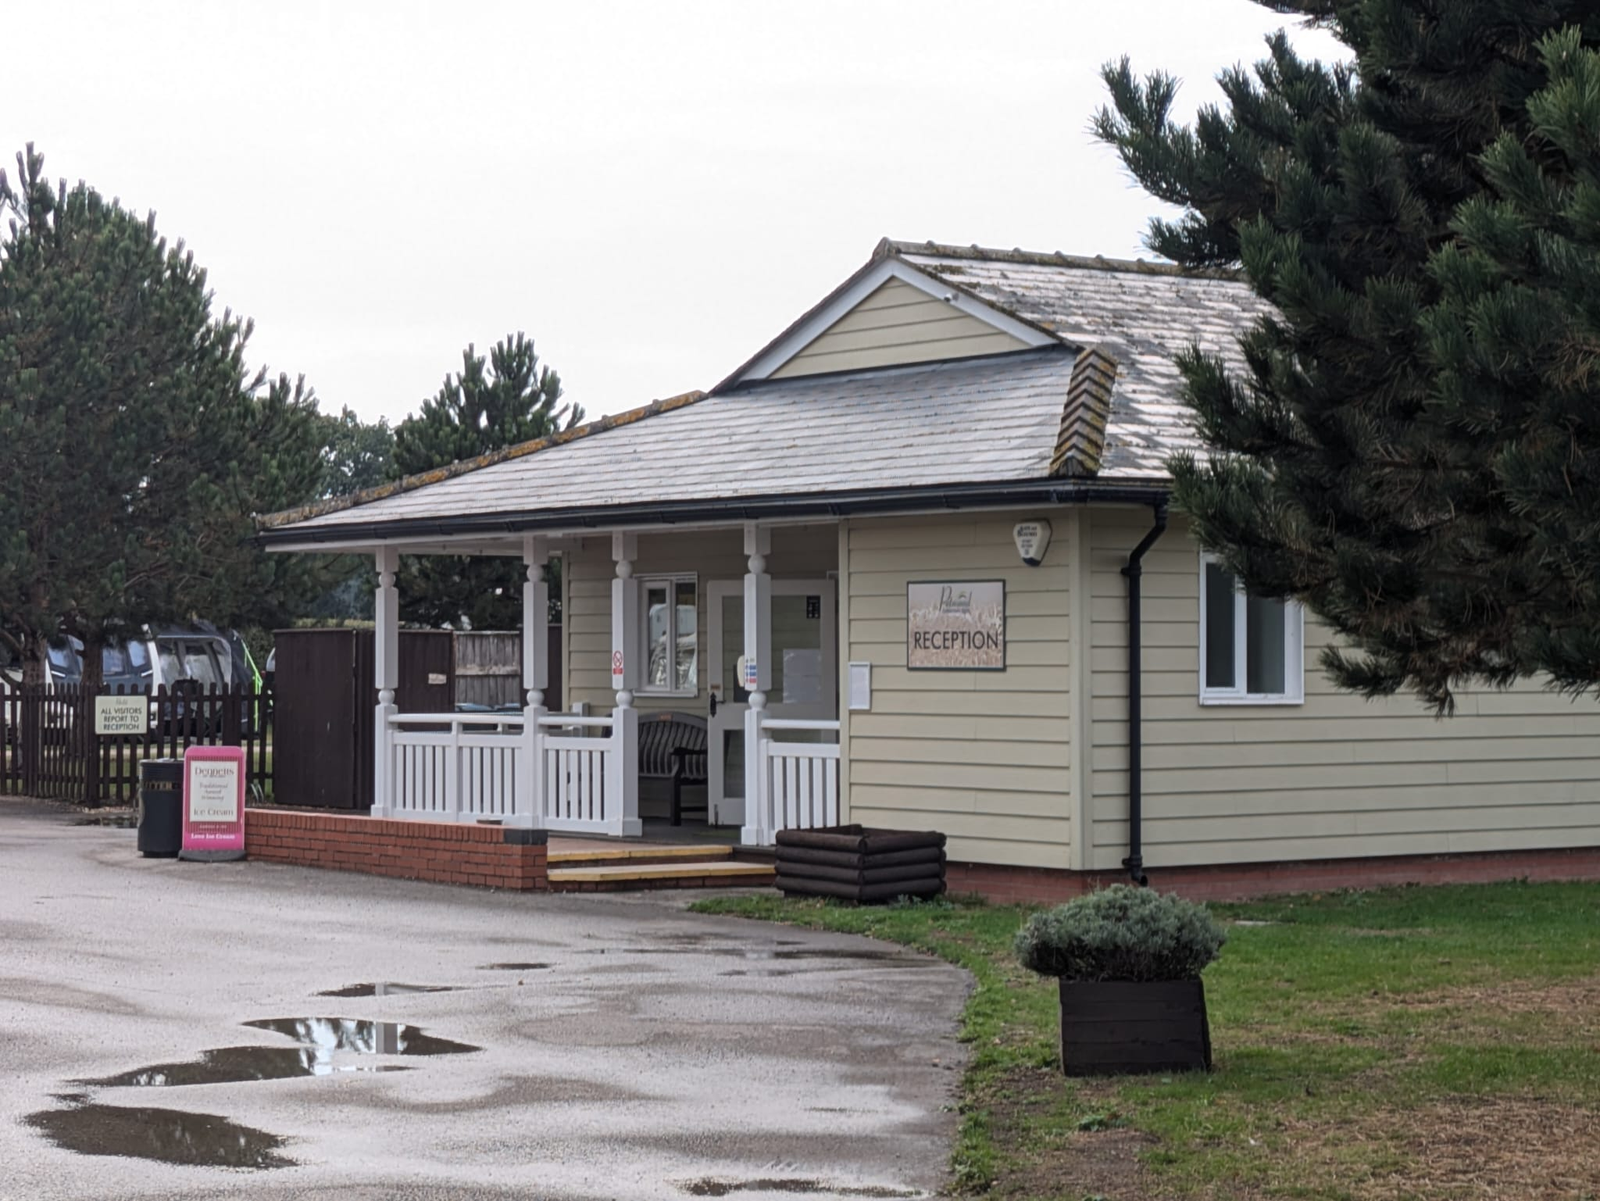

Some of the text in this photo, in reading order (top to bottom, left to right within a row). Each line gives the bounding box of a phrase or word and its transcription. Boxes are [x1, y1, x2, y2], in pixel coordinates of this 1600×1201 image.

[914, 631, 999, 650] RECEPTION
[101, 707, 142, 715] ALL VISITORS
[104, 715, 139, 723] REPORT TO
[104, 723, 139, 731] RECEPTION
[194, 808, 234, 816] Ice Cream
